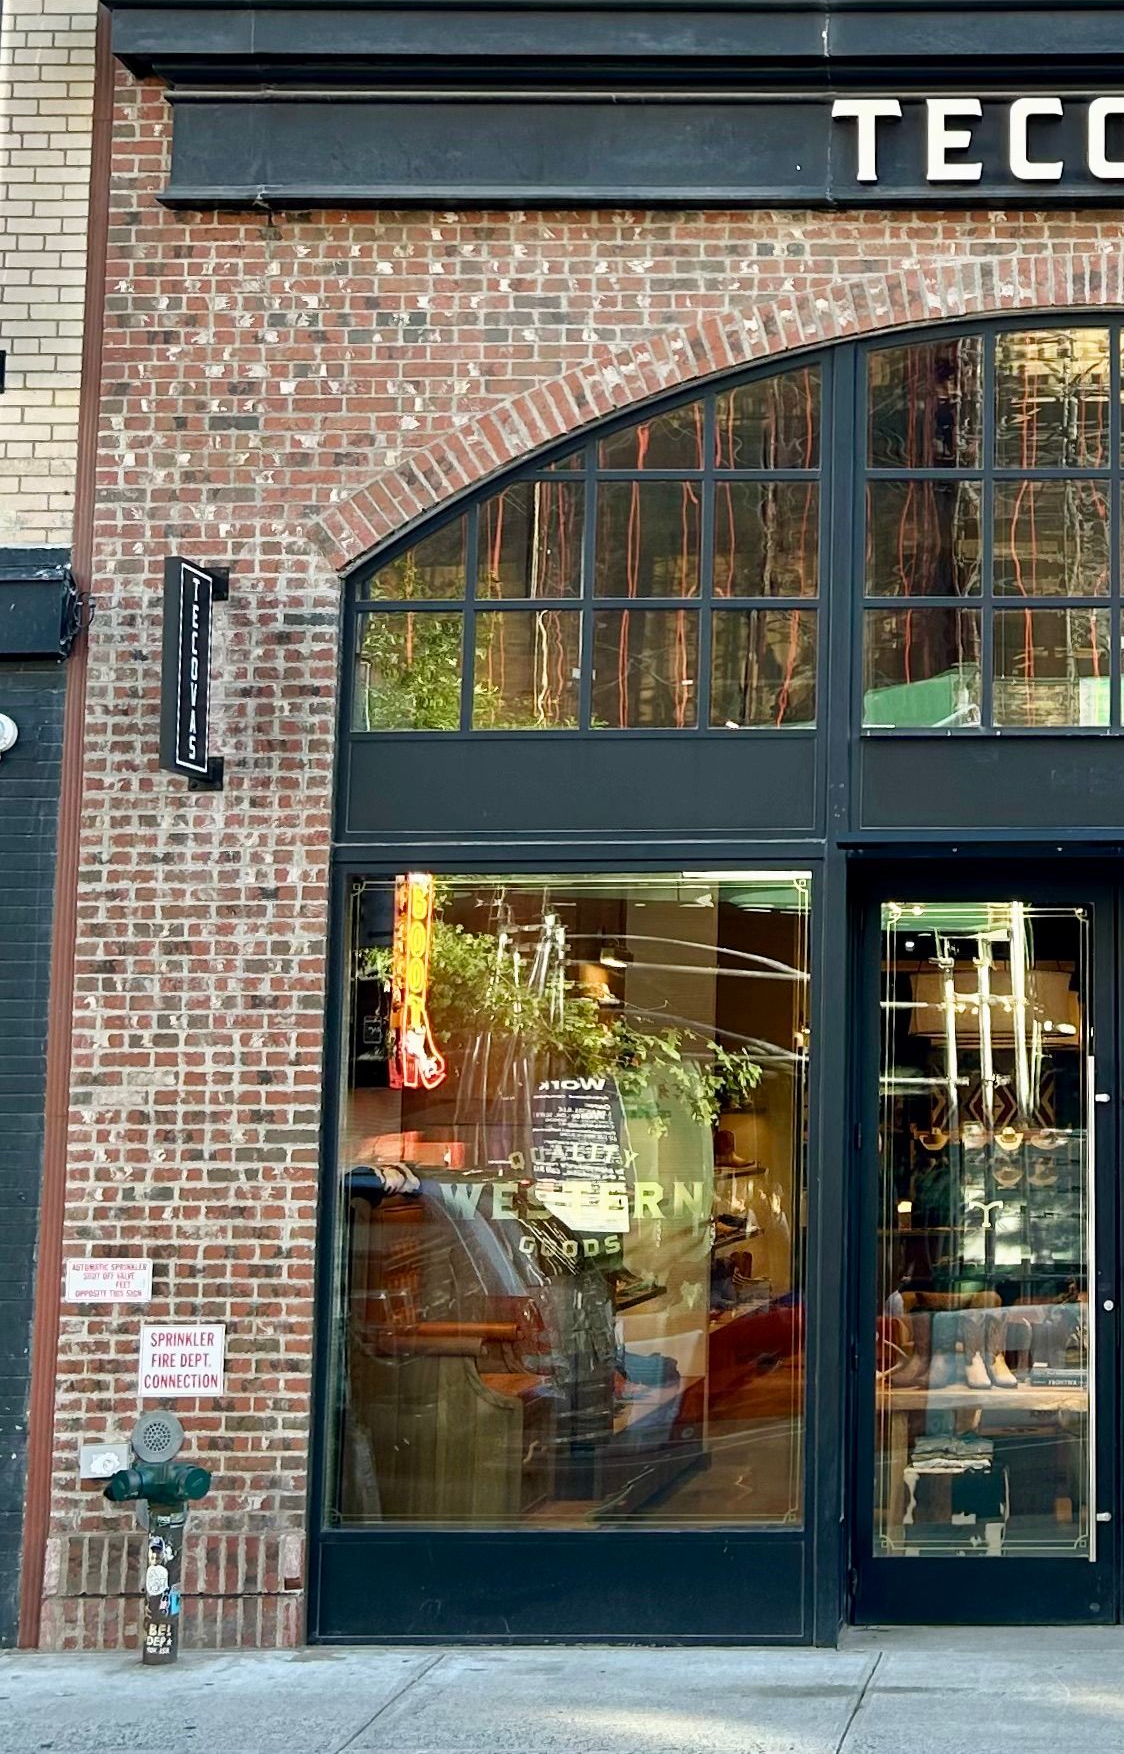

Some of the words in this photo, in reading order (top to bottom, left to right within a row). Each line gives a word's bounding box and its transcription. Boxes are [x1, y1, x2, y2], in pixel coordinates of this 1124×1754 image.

[188, 577, 201, 760] TECOVAS
[507, 1143, 640, 1171] QUALITY
[439, 1181, 705, 1220] WESTERN
[518, 1234, 622, 1259] GOODS
[115, 1280, 132, 1289] FEET
[150, 1332, 214, 1347] SPRINKLER
[151, 1353, 176, 1367] FIRE
[180, 1353, 212, 1367] DEPT.
[144, 1374, 218, 1389] CONNECTION
